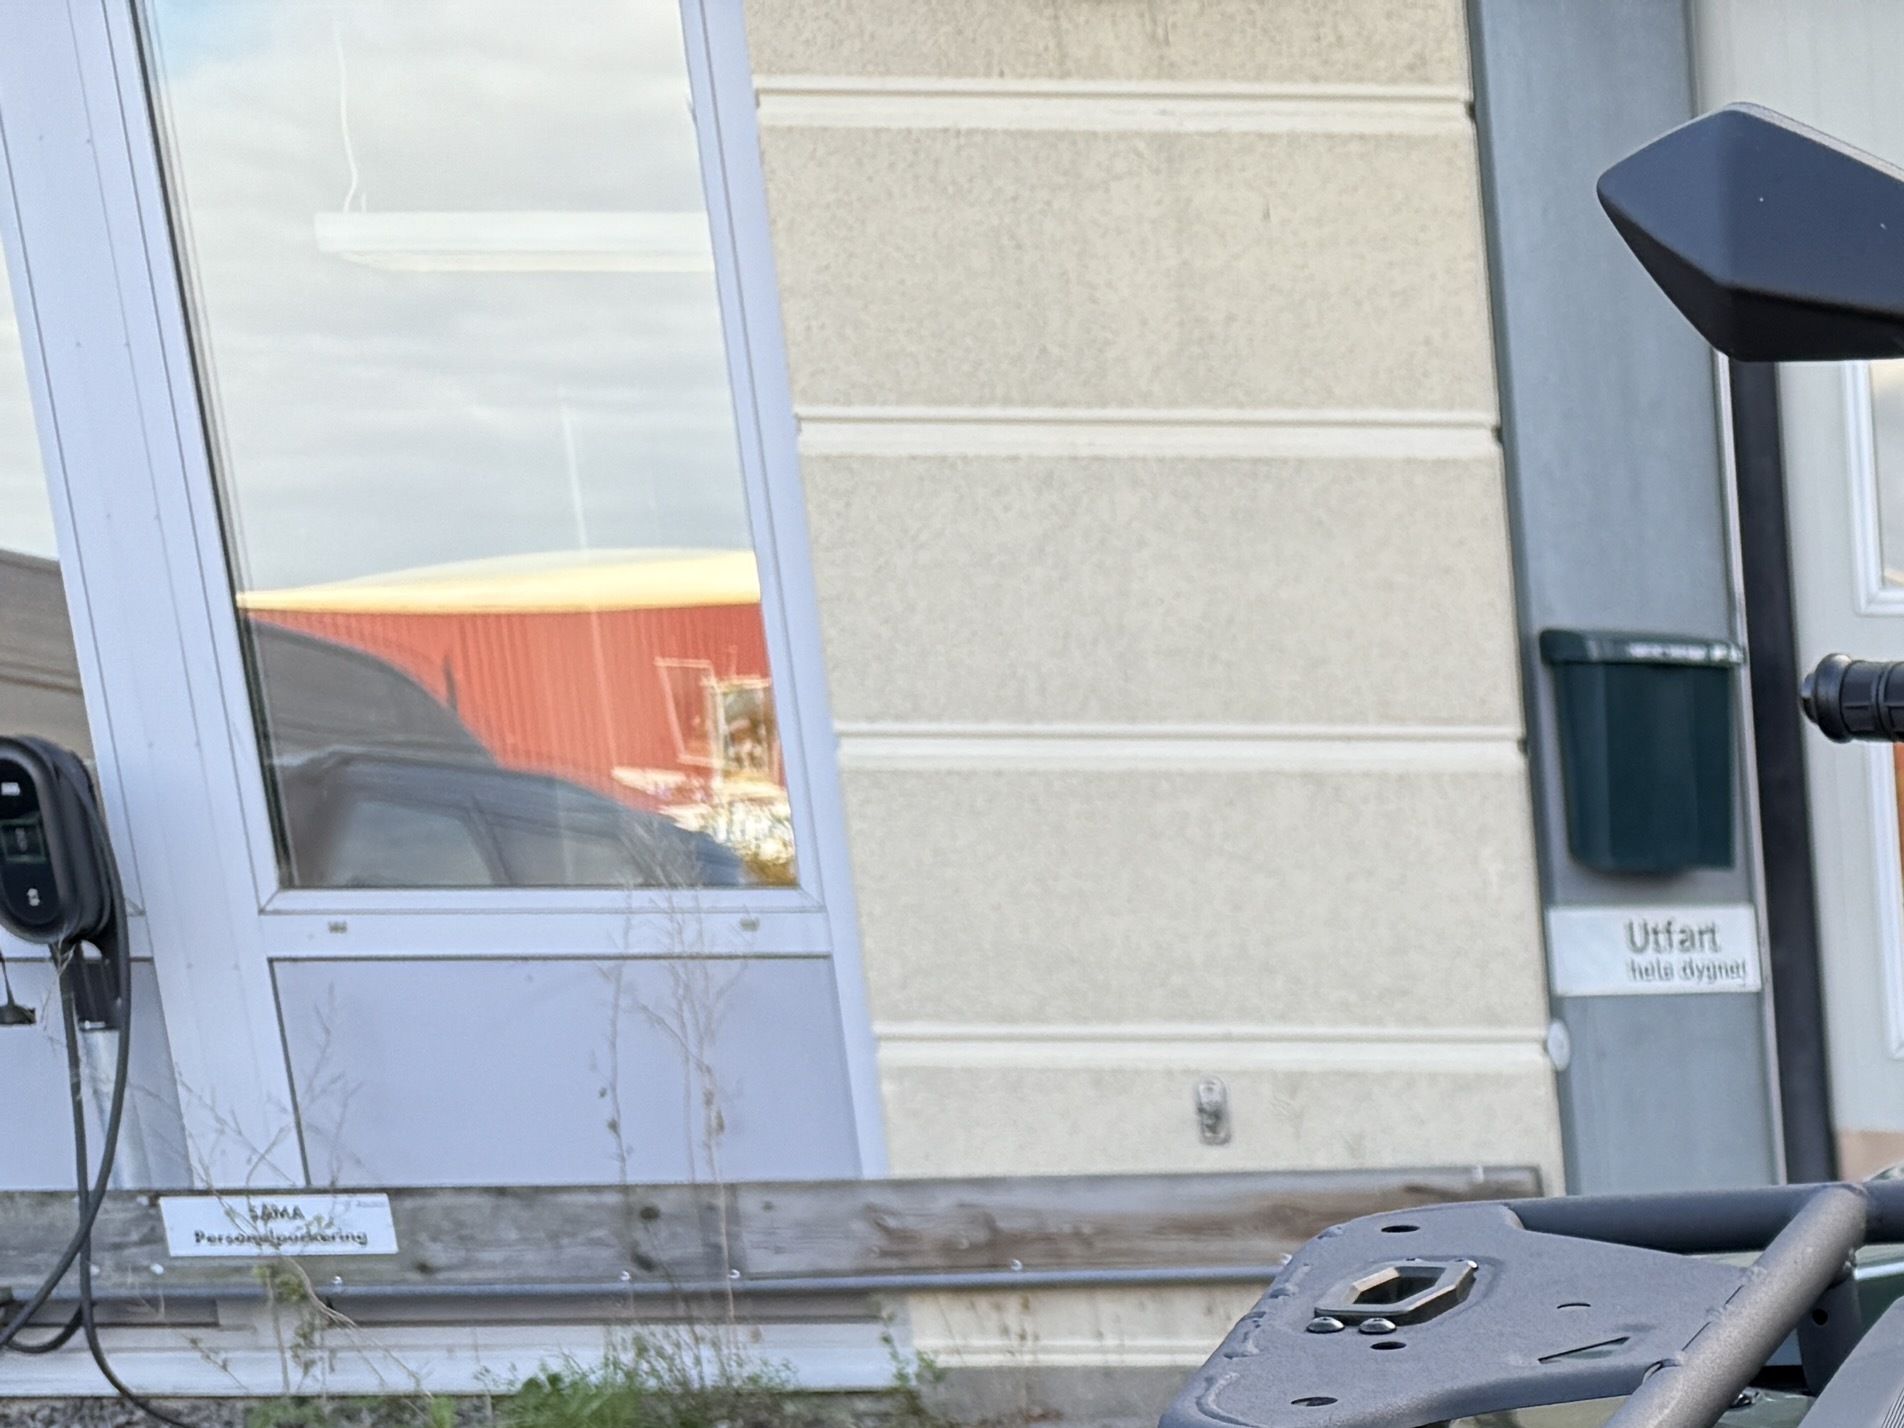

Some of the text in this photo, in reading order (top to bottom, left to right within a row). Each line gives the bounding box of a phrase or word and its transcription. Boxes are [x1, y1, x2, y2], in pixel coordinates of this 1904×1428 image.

[1626, 919, 1719, 953] Utfart
[1630, 957, 1747, 985] hela dygnet
